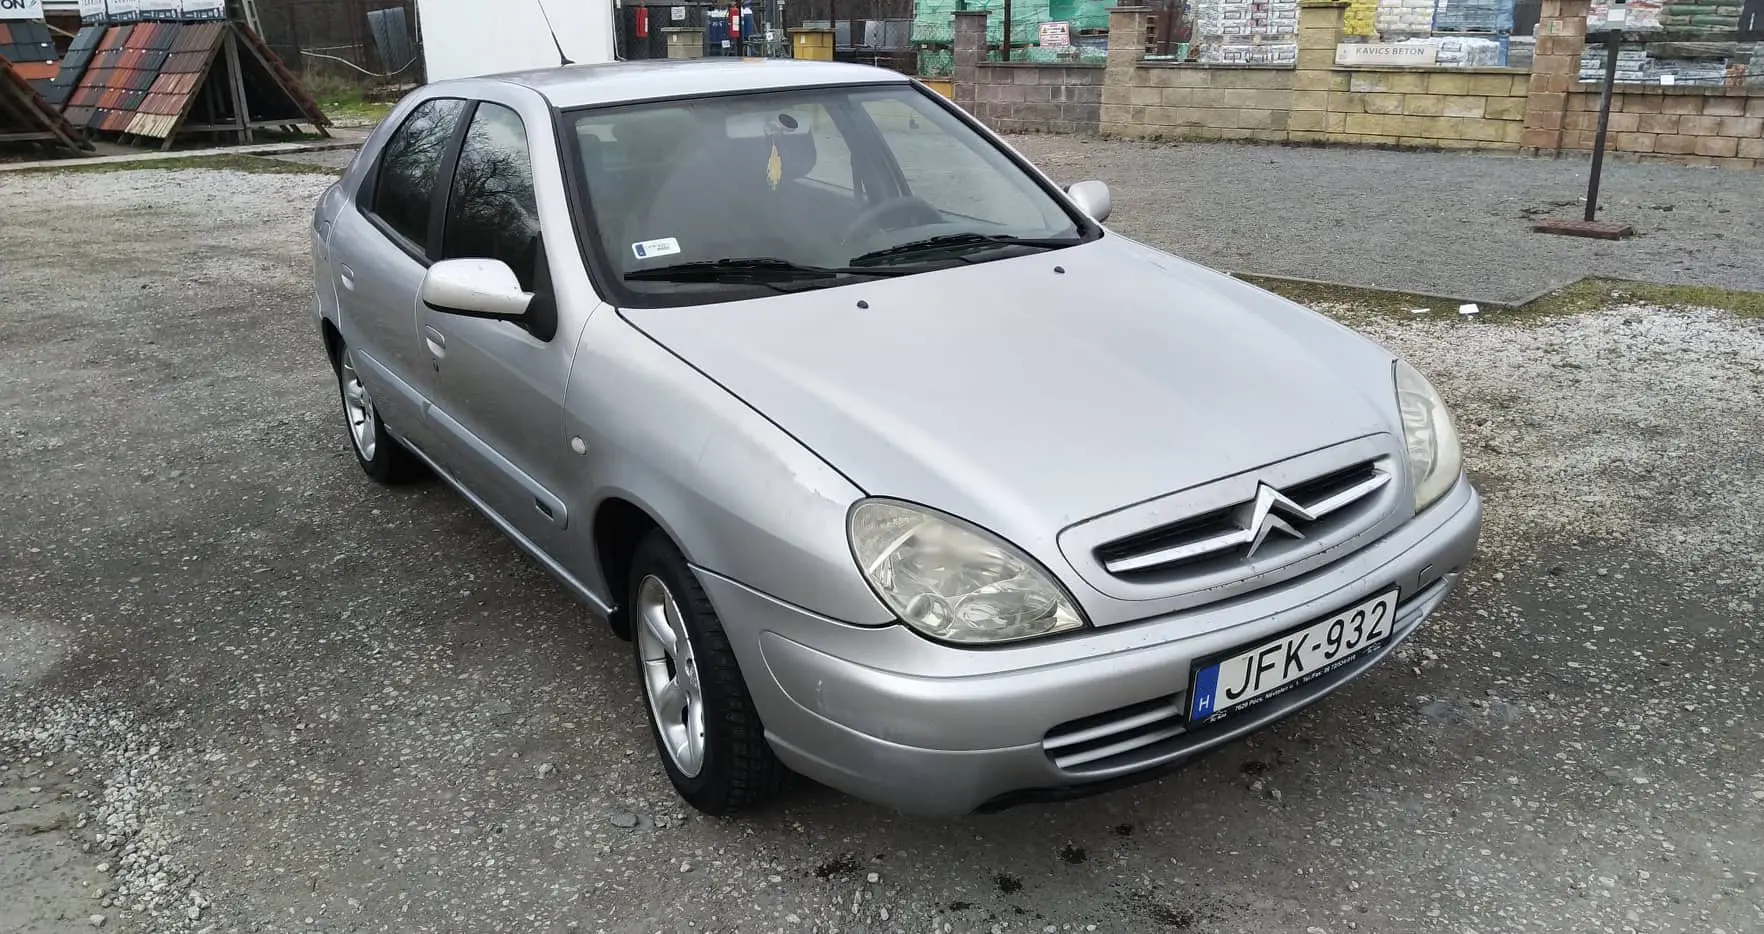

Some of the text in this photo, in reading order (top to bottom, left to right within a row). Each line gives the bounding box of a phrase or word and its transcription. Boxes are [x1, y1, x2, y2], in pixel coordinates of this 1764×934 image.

[1356, 47, 1390, 56] KAVICS
[1392, 47, 1425, 56] BETON
[1225, 601, 1387, 700] JFK-932
[1198, 694, 1210, 713] H
